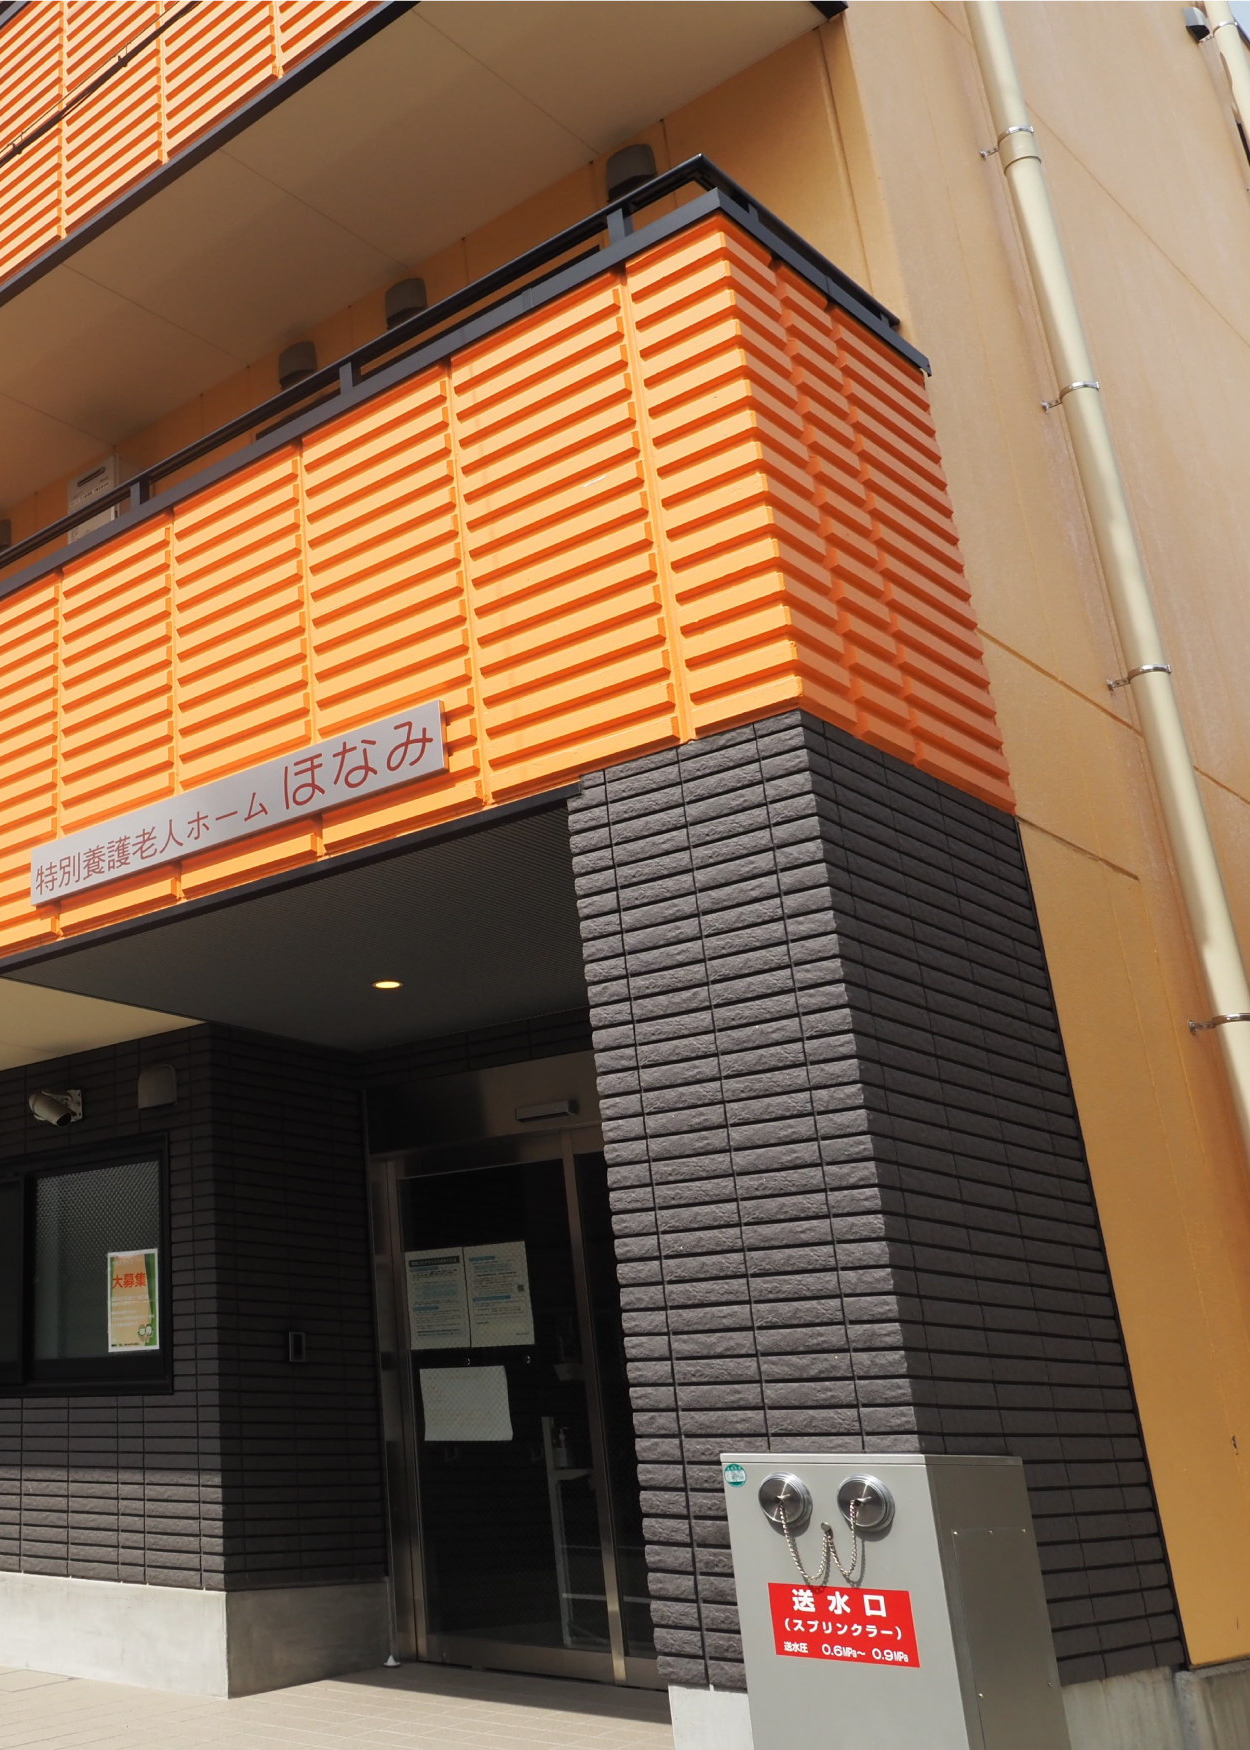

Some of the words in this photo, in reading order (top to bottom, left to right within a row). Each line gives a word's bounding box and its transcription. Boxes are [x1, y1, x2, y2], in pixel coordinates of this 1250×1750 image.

[36, 792, 268, 895] 特別養護老人ホーム
[284, 721, 433, 810] ほなみ
[112, 1272, 146, 1289] 大募集
[783, 1641, 808, 1653] 送水圧
[871, 1648, 909, 1662] 0.9MPa
